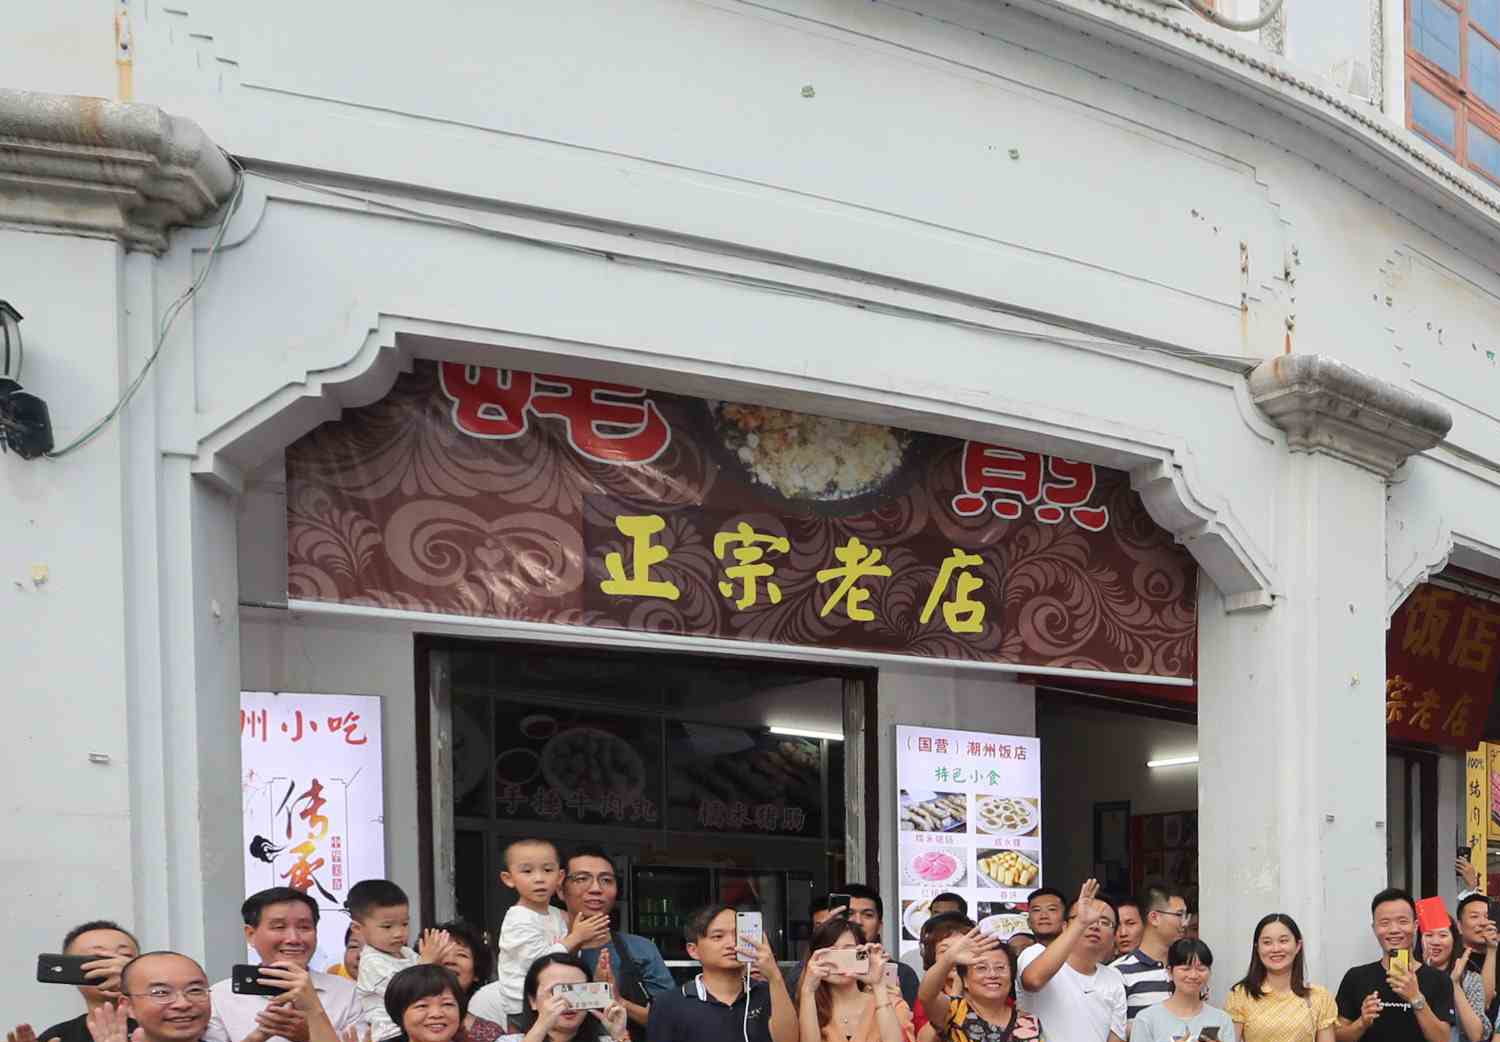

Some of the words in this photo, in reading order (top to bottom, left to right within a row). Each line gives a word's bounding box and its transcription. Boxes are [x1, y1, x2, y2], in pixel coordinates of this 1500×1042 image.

[600, 514, 985, 633] 正宗老店
[240, 709, 368, 745] 州小吃
[934, 766, 1001, 786] 特色小食
